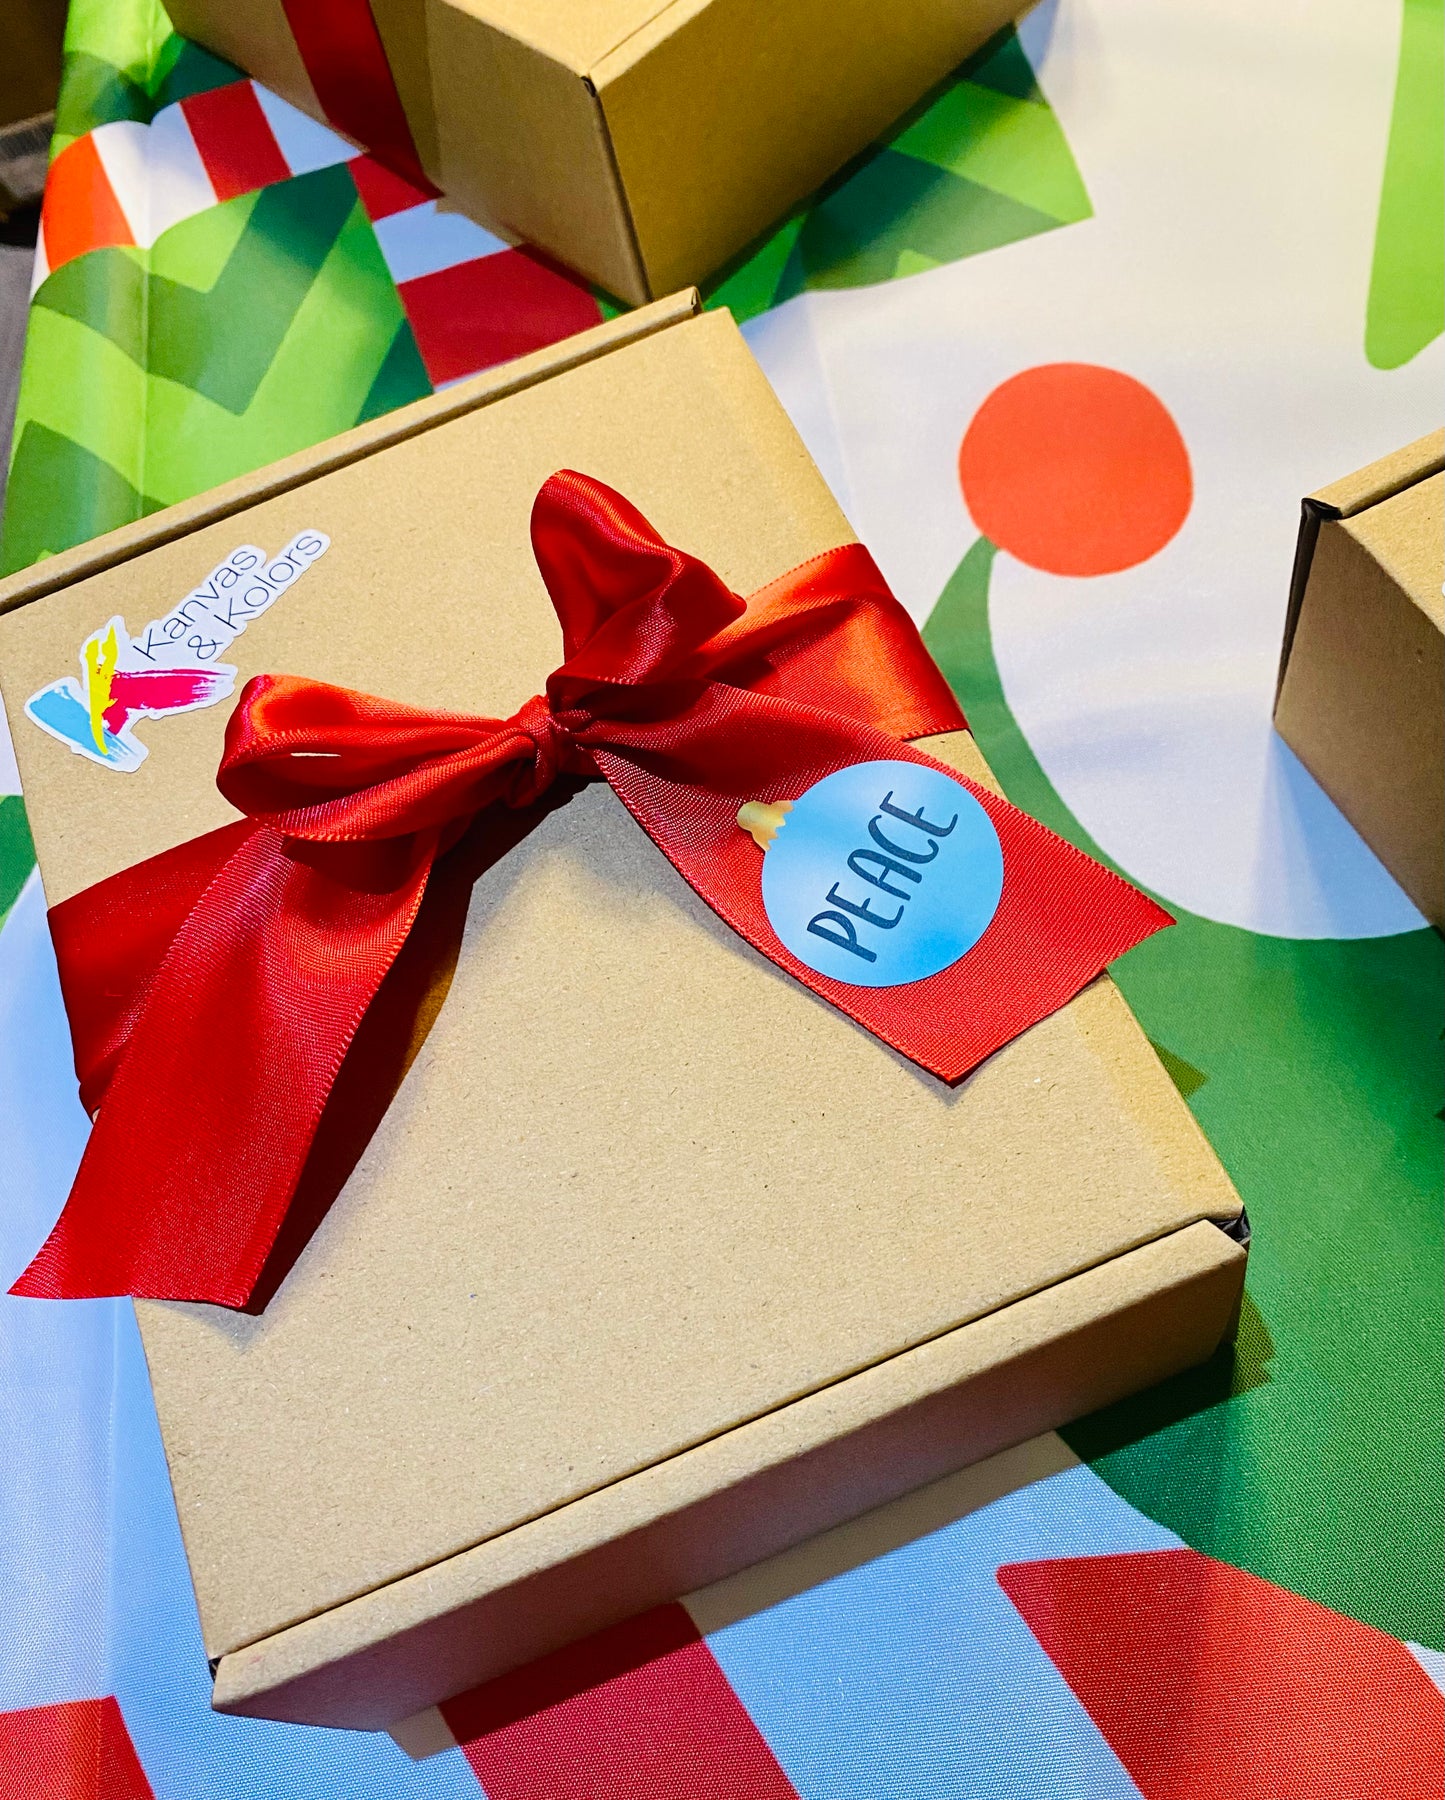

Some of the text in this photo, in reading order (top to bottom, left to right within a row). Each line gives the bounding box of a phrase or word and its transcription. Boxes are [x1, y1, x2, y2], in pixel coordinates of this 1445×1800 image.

[133, 550, 258, 661] Kanvas
[187, 535, 322, 660] & Kolors
[806, 790, 959, 963] PEACE
